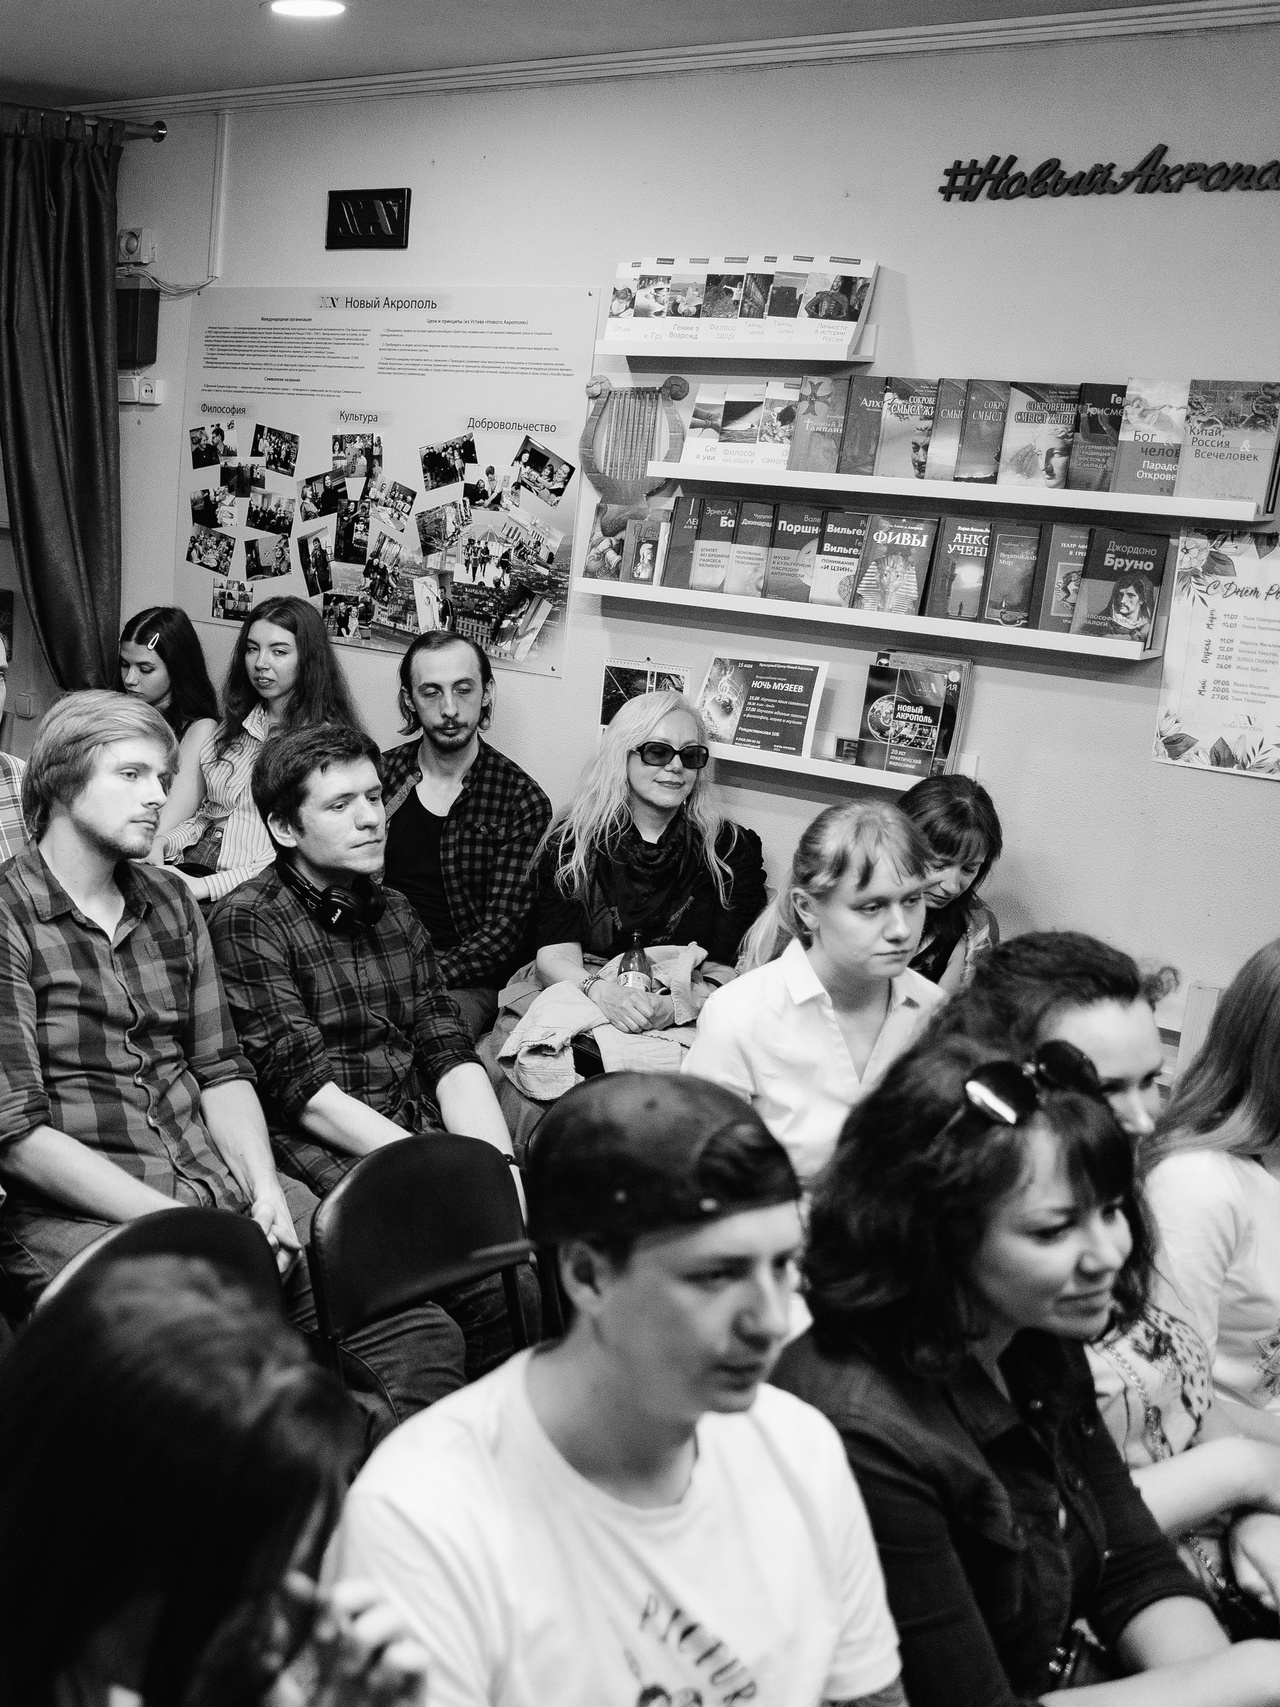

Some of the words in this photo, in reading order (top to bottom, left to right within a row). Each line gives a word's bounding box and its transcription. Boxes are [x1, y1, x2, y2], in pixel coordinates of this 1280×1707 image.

[345, 297, 380, 309] Новый
[383, 297, 438, 311] Акрополь
[816, 323, 848, 331] Личности
[201, 403, 246, 416] Философия
[891, 404, 921, 415] СМЫСЛ
[972, 410, 1003, 422] СМЫСЛ
[339, 410, 378, 424] Культура
[1014, 411, 1047, 424] СМЫСЛ
[467, 417, 557, 433] Добровольчество
[1133, 431, 1157, 443] Бог
[1191, 437, 1230, 448] Россия
[1194, 450, 1259, 462] Всечеловек
[720, 516, 735, 528] Ба
[873, 530, 928, 548] ФИВЫ
[1106, 540, 1157, 557] Джордано
[1103, 553, 1154, 572] Бруно
[1206, 580, 1221, 596] С
[1222, 581, 1261, 599] Днём
[751, 680, 772, 690] НОЧЬ
[772, 682, 804, 693] МУЗЕЕВ
[897, 704, 924, 714] НОВЫЙ
[895, 712, 933, 724] АКРОПОЛЬ
